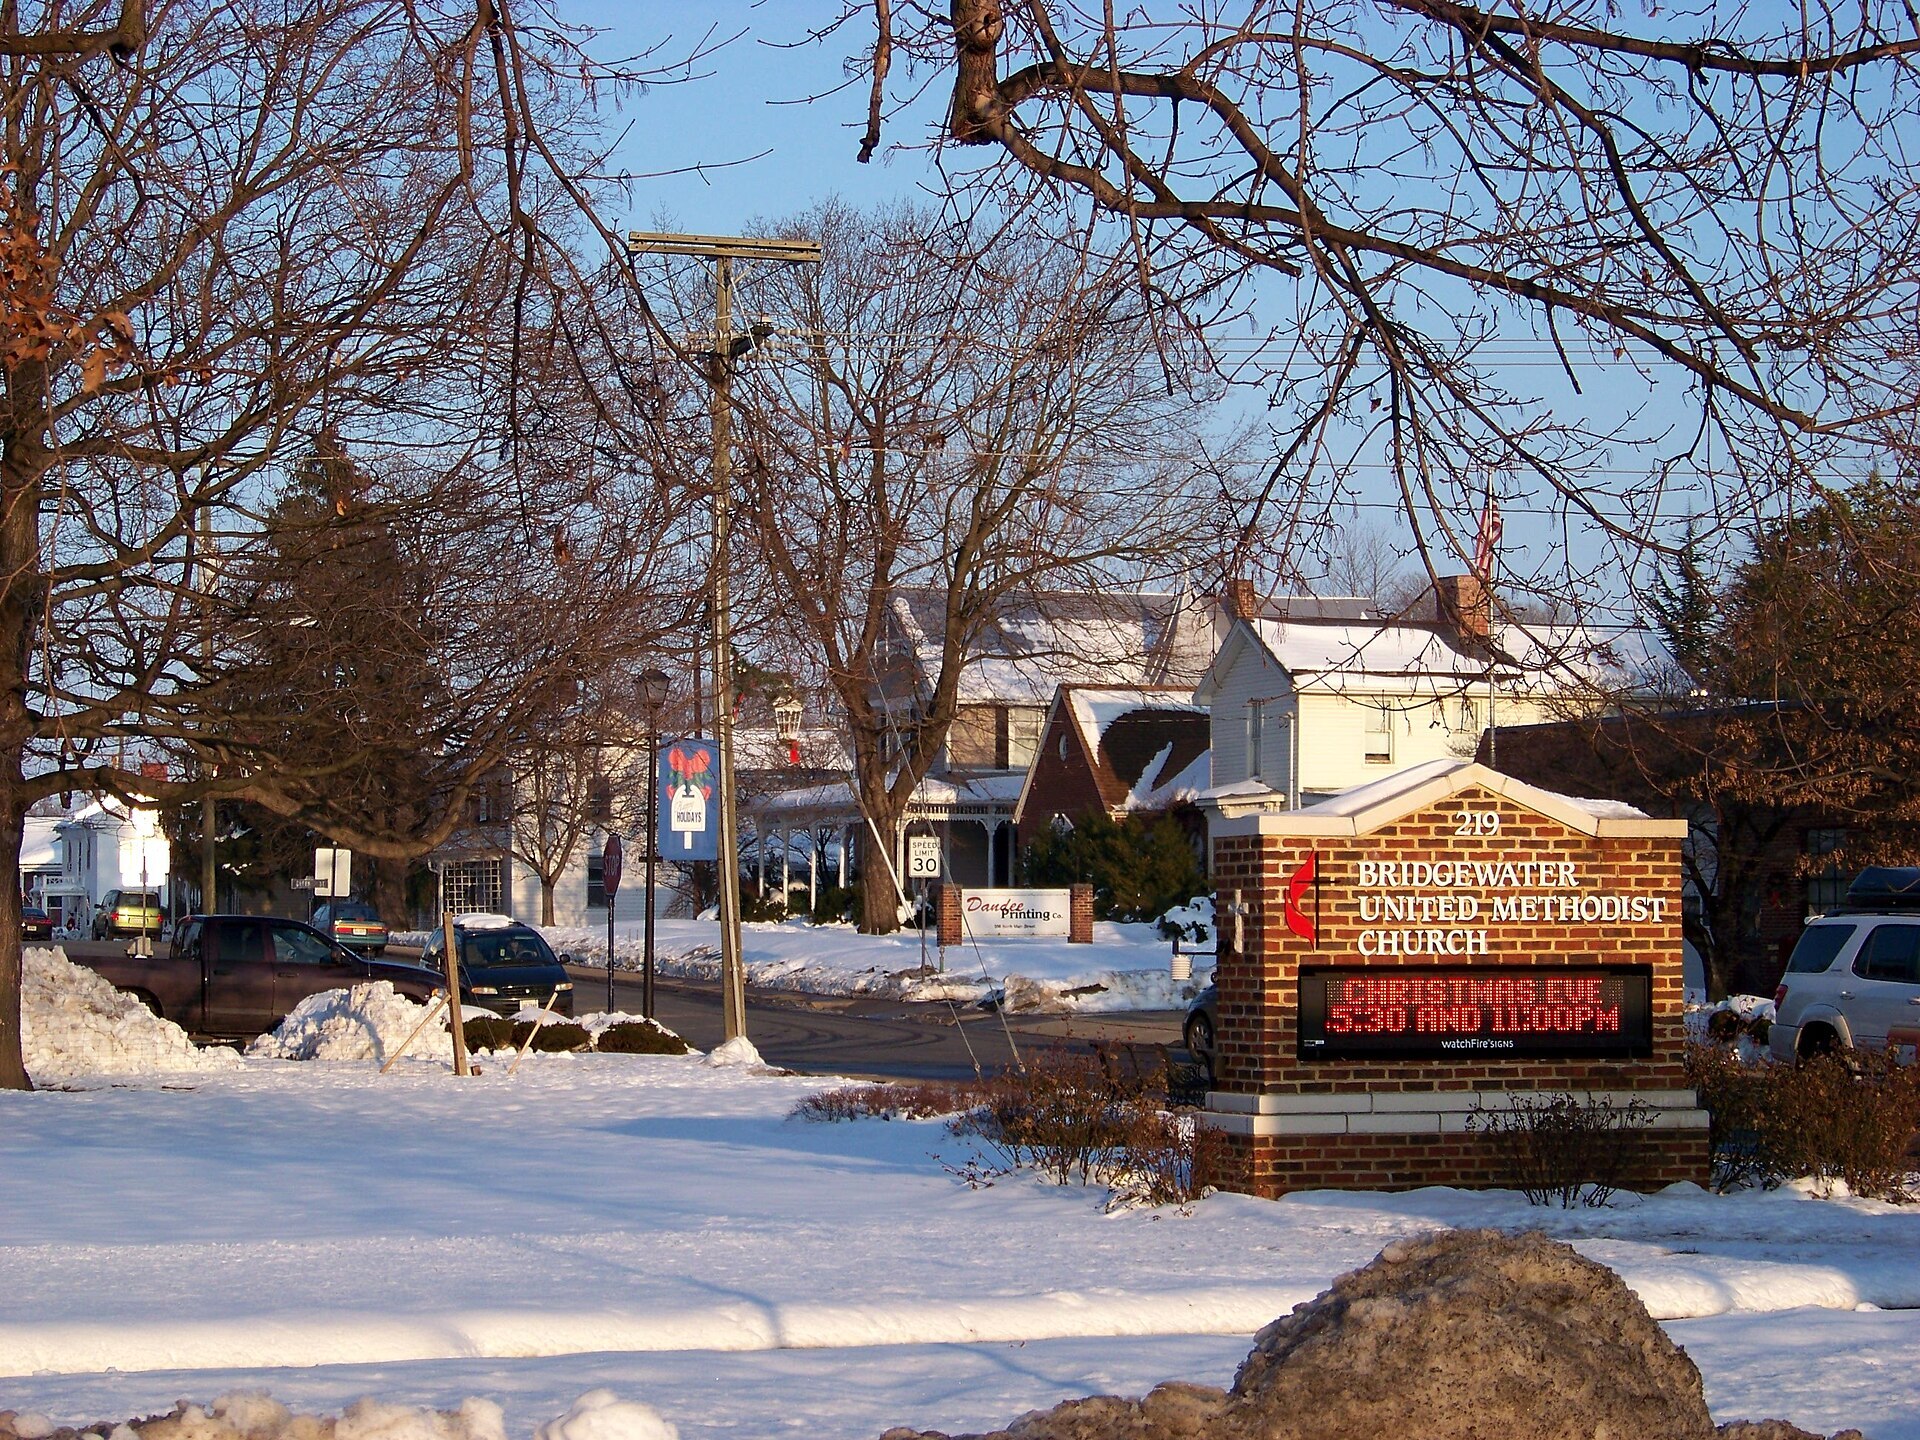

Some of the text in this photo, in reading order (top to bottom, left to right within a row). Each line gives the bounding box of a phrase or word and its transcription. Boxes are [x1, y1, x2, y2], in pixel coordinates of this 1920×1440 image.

[676, 811, 702, 823] HOLIDAYS
[1453, 811, 1500, 836] 219
[604, 854, 620, 876] STOP
[914, 858, 936, 872] 30
[1357, 861, 1579, 888] BRIDGEWATER
[966, 897, 1024, 912] Dandee
[1001, 908, 1050, 921] Printing
[1357, 896, 1666, 923] UNITED METHODIST
[1357, 929, 1488, 956] CHURCH
[1343, 978, 1604, 1005] CHRISTMAS EVE
[1326, 1005, 1620, 1033] 5:30 AND 11:00PM
